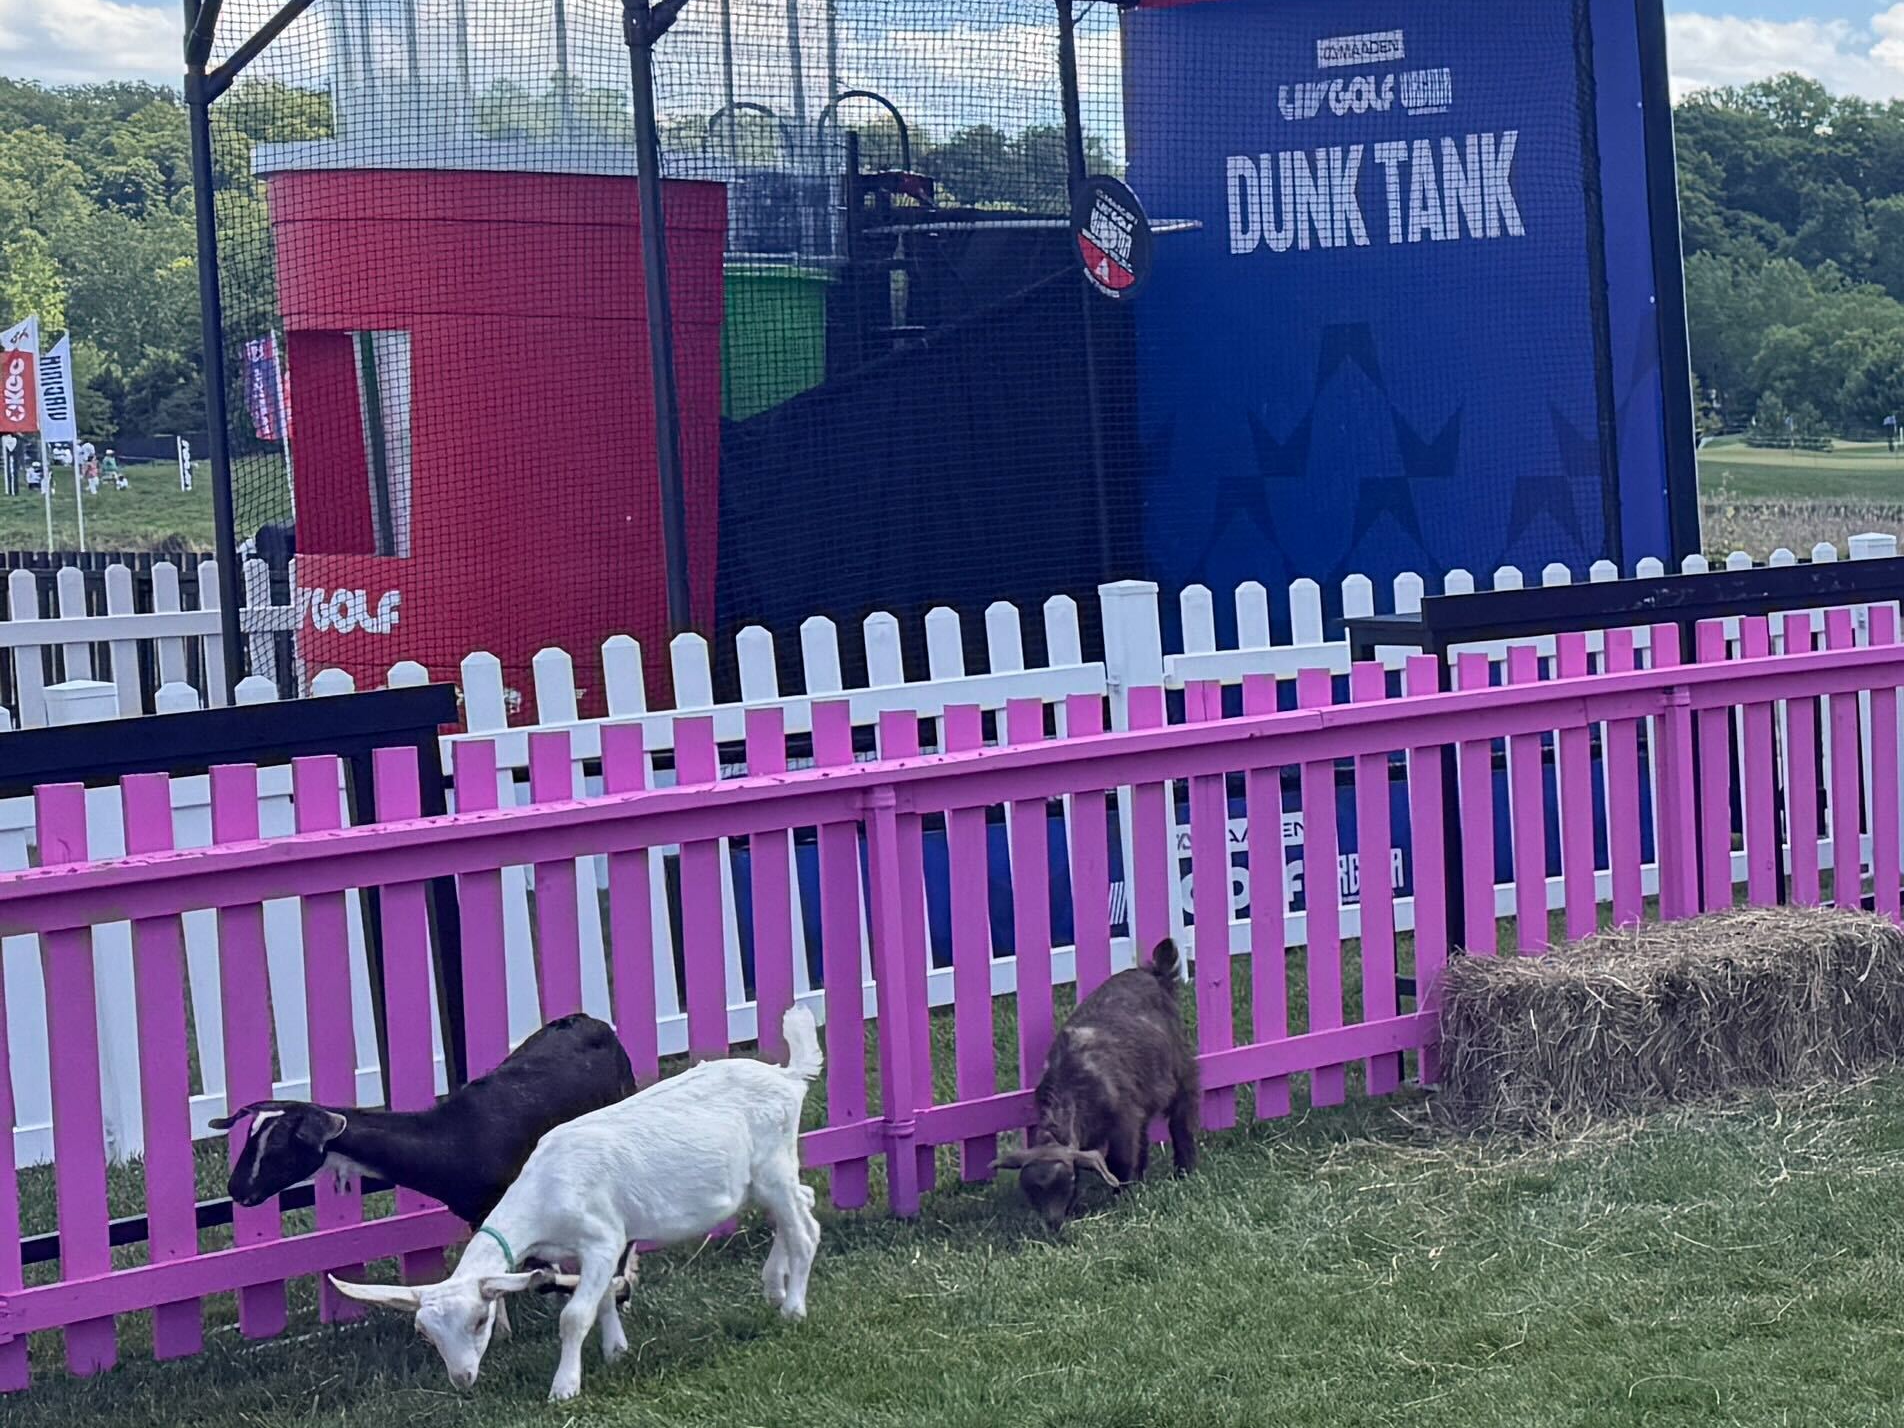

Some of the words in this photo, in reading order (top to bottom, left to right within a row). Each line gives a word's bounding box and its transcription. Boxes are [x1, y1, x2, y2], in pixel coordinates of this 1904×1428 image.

[1328, 74, 1395, 116] GOLF
[1226, 144, 1370, 254] DUNK
[1374, 131, 1526, 244] TANK
[311, 587, 401, 634] GOLF
